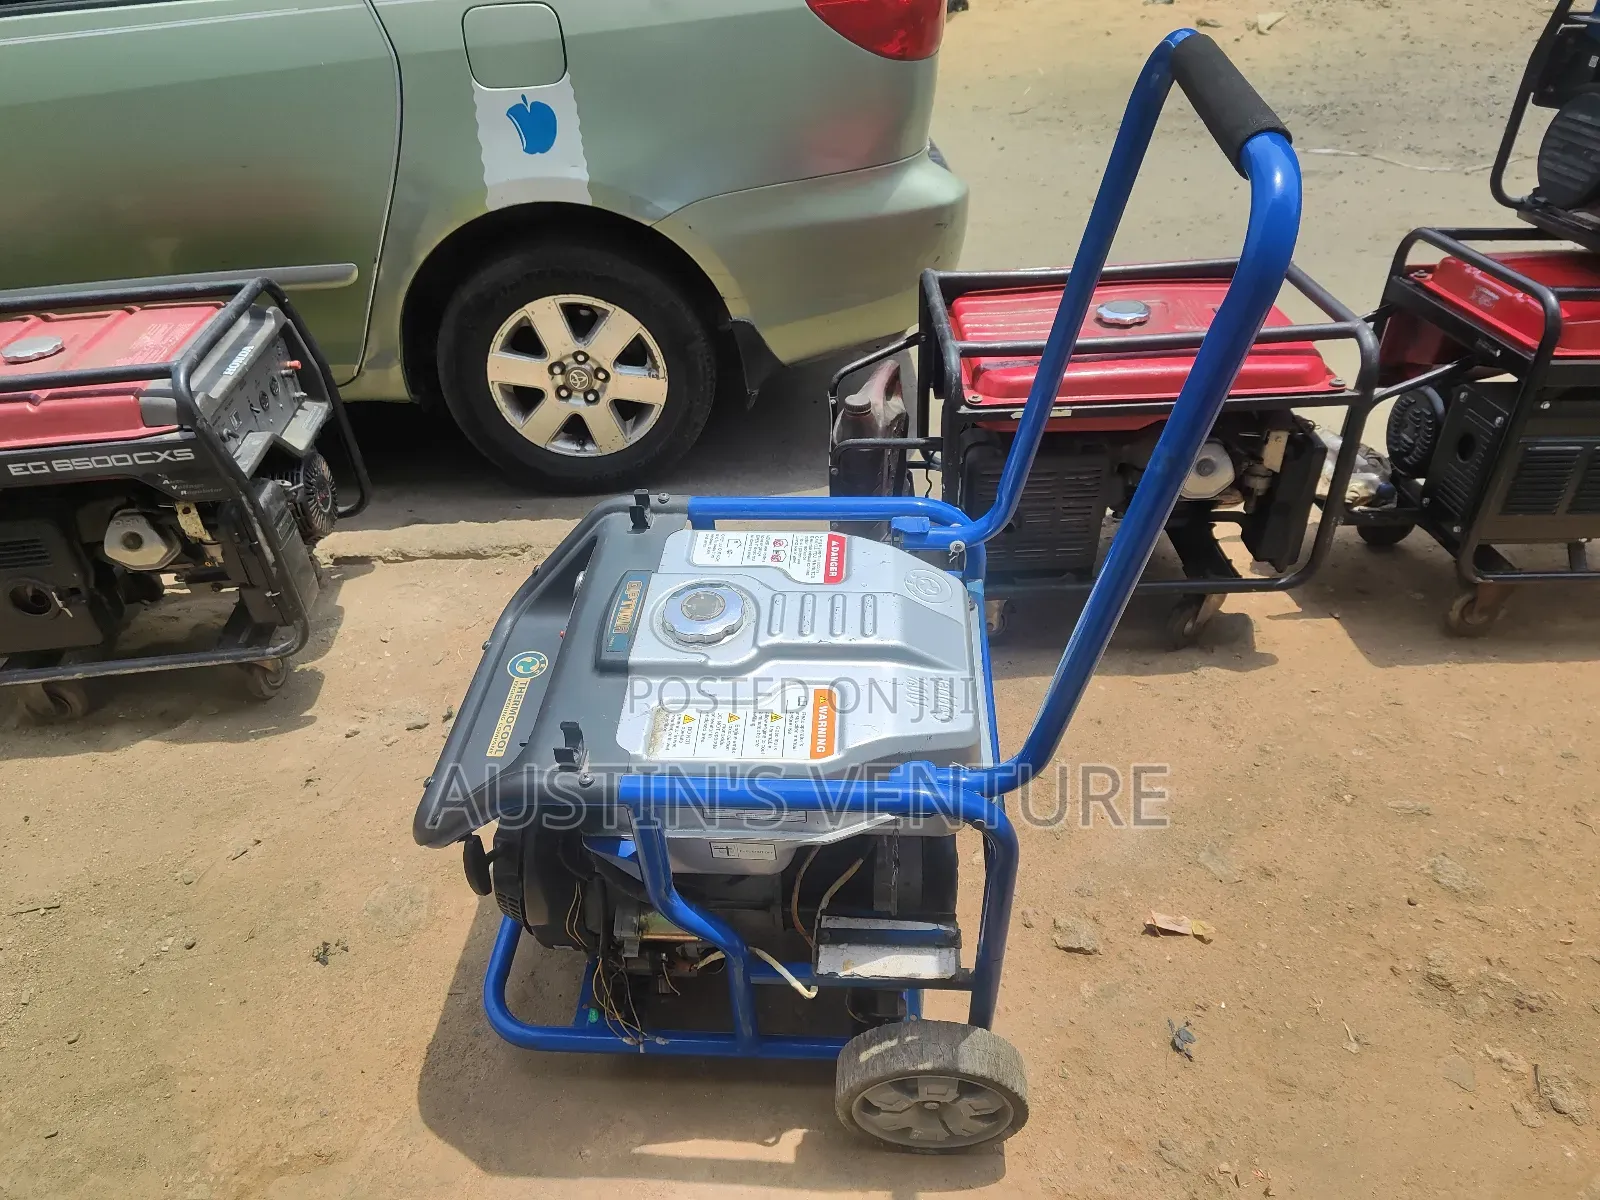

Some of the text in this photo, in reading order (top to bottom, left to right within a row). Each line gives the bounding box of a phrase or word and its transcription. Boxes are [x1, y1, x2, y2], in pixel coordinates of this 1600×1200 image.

[222, 345, 255, 377] HONDA
[7, 461, 52, 476] EG
[827, 546, 840, 578] DANGER
[494, 680, 529, 757] THERMOCOOL
[815, 705, 828, 753] WARNING
[488, 722, 504, 755] COMPANY
